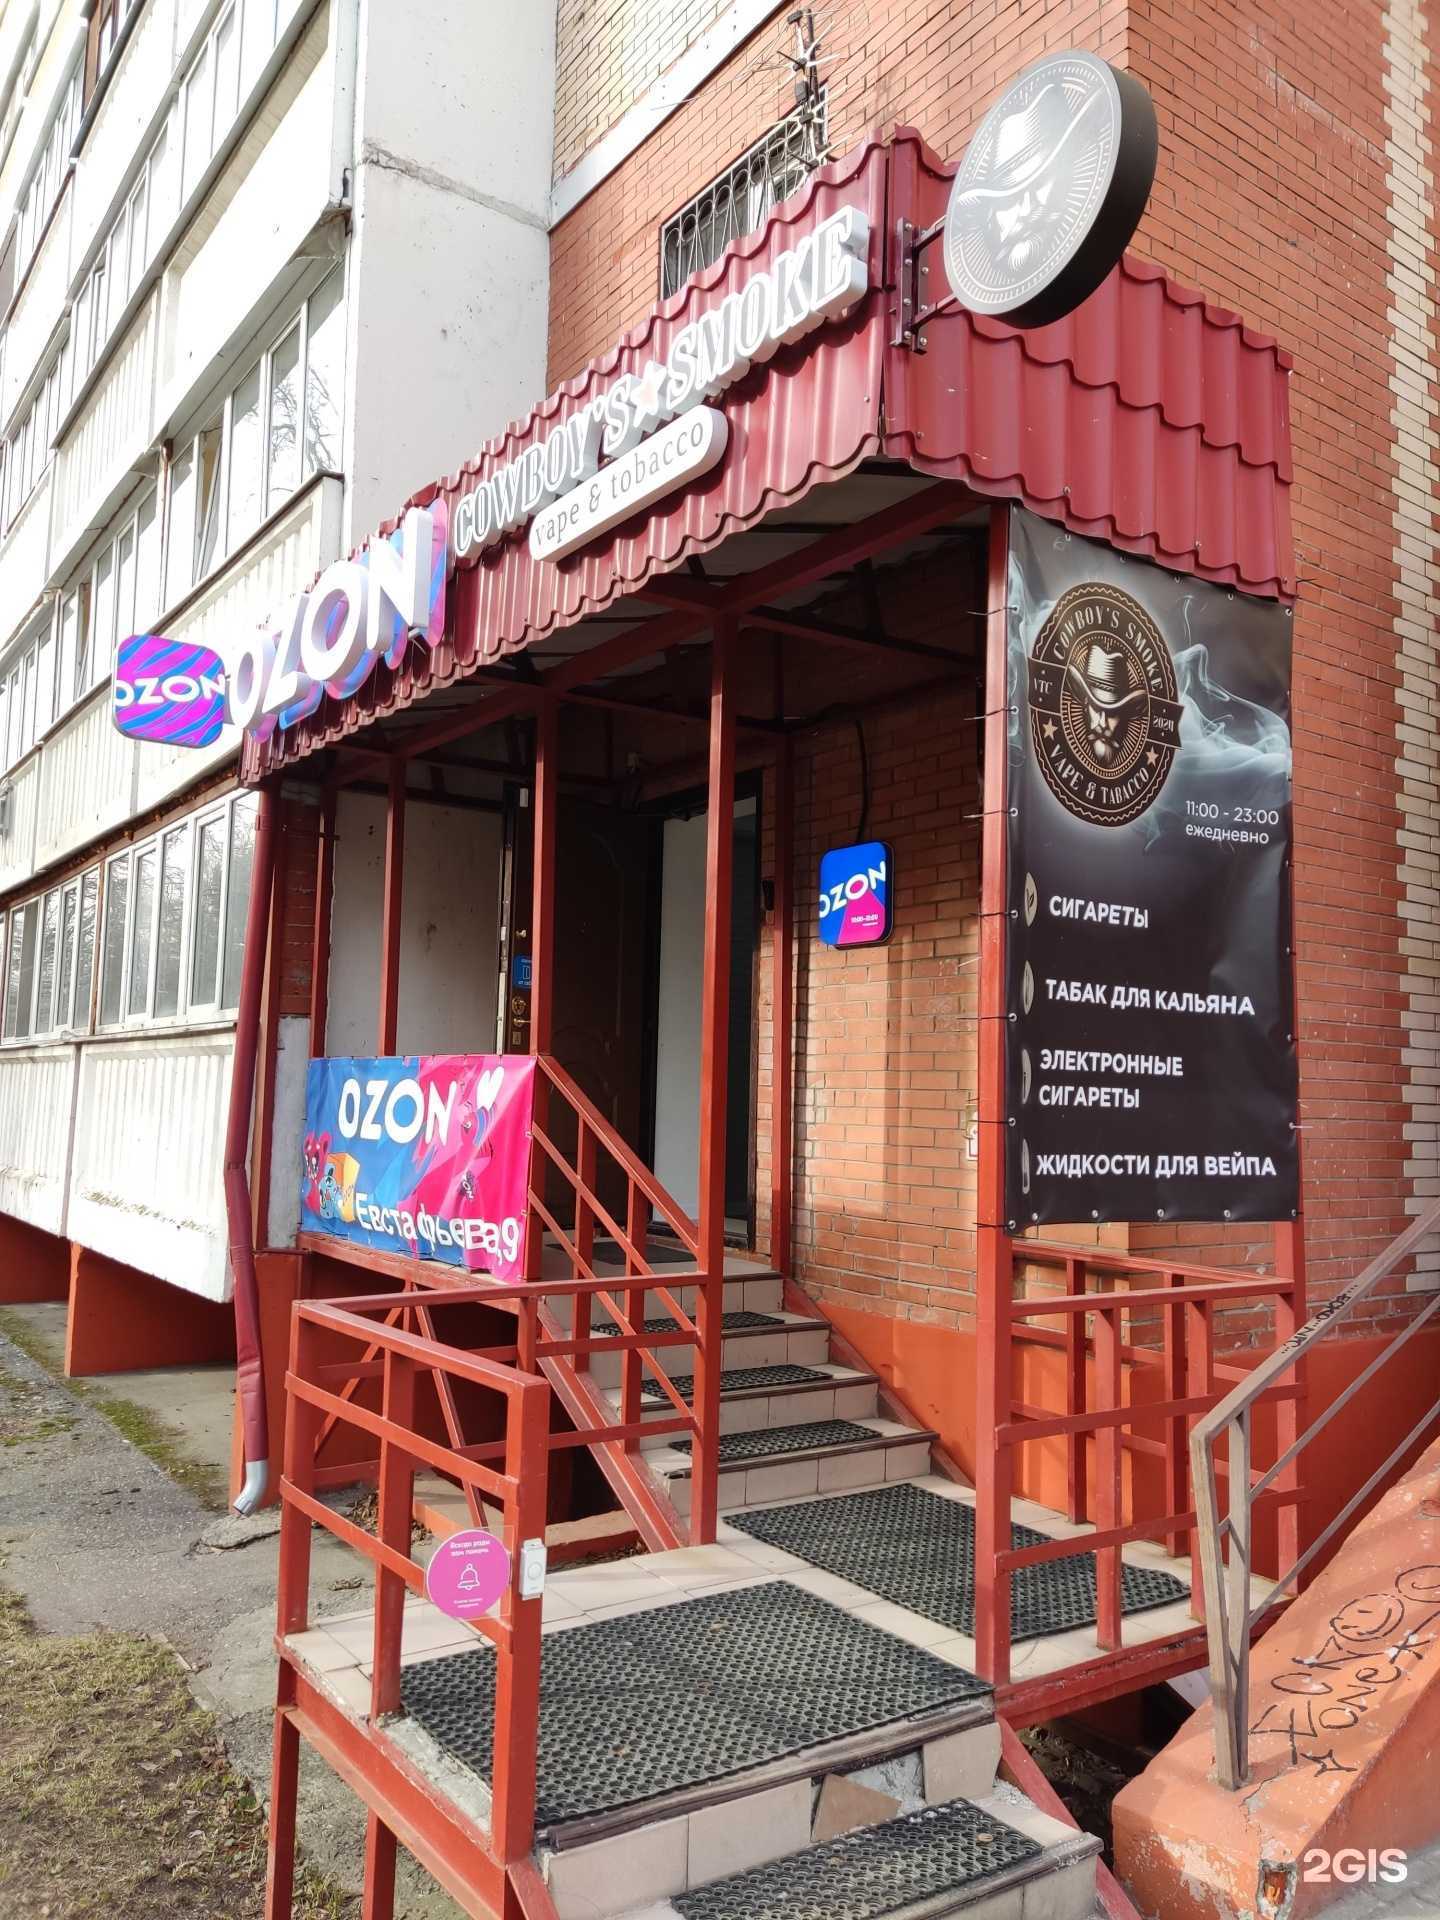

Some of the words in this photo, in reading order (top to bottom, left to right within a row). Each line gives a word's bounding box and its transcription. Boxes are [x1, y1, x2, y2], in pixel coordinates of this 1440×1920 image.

[455, 375, 636, 557] COWBOY'S
[665, 206, 866, 410] SMOKE
[535, 502, 580, 549] vape
[589, 488, 602, 514] &
[610, 420, 705, 500] tobacco
[227, 506, 434, 731] OZON
[1052, 605, 1121, 661] COWBOY'S
[1125, 622, 1164, 693] SMOKE
[1050, 744, 1084, 790] VAPE
[1086, 783, 1097, 799] &
[1185, 800, 1219, 819] 11:00
[1233, 806, 1280, 825] 23:00
[1185, 823, 1270, 845] ежедневно
[1049, 895, 1149, 929] СИГАРЕТЫ
[1045, 978, 1107, 1004] ТАБАК
[1110, 986, 1151, 1010] ДЛЯ
[1155, 990, 1255, 1016] КАЛЬЯНА
[1040, 1048, 1184, 1077] ЭЛЕКТРОННЫЕ
[337, 1077, 458, 1147] OZON
[1039, 1084, 1140, 1109] СИГАРЕТЫ
[1036, 1153, 1150, 1179] ЖИДКОСТИ
[1155, 1154, 1199, 1180] ДЛЯ
[1204, 1151, 1278, 1177] ВЕЙПА
